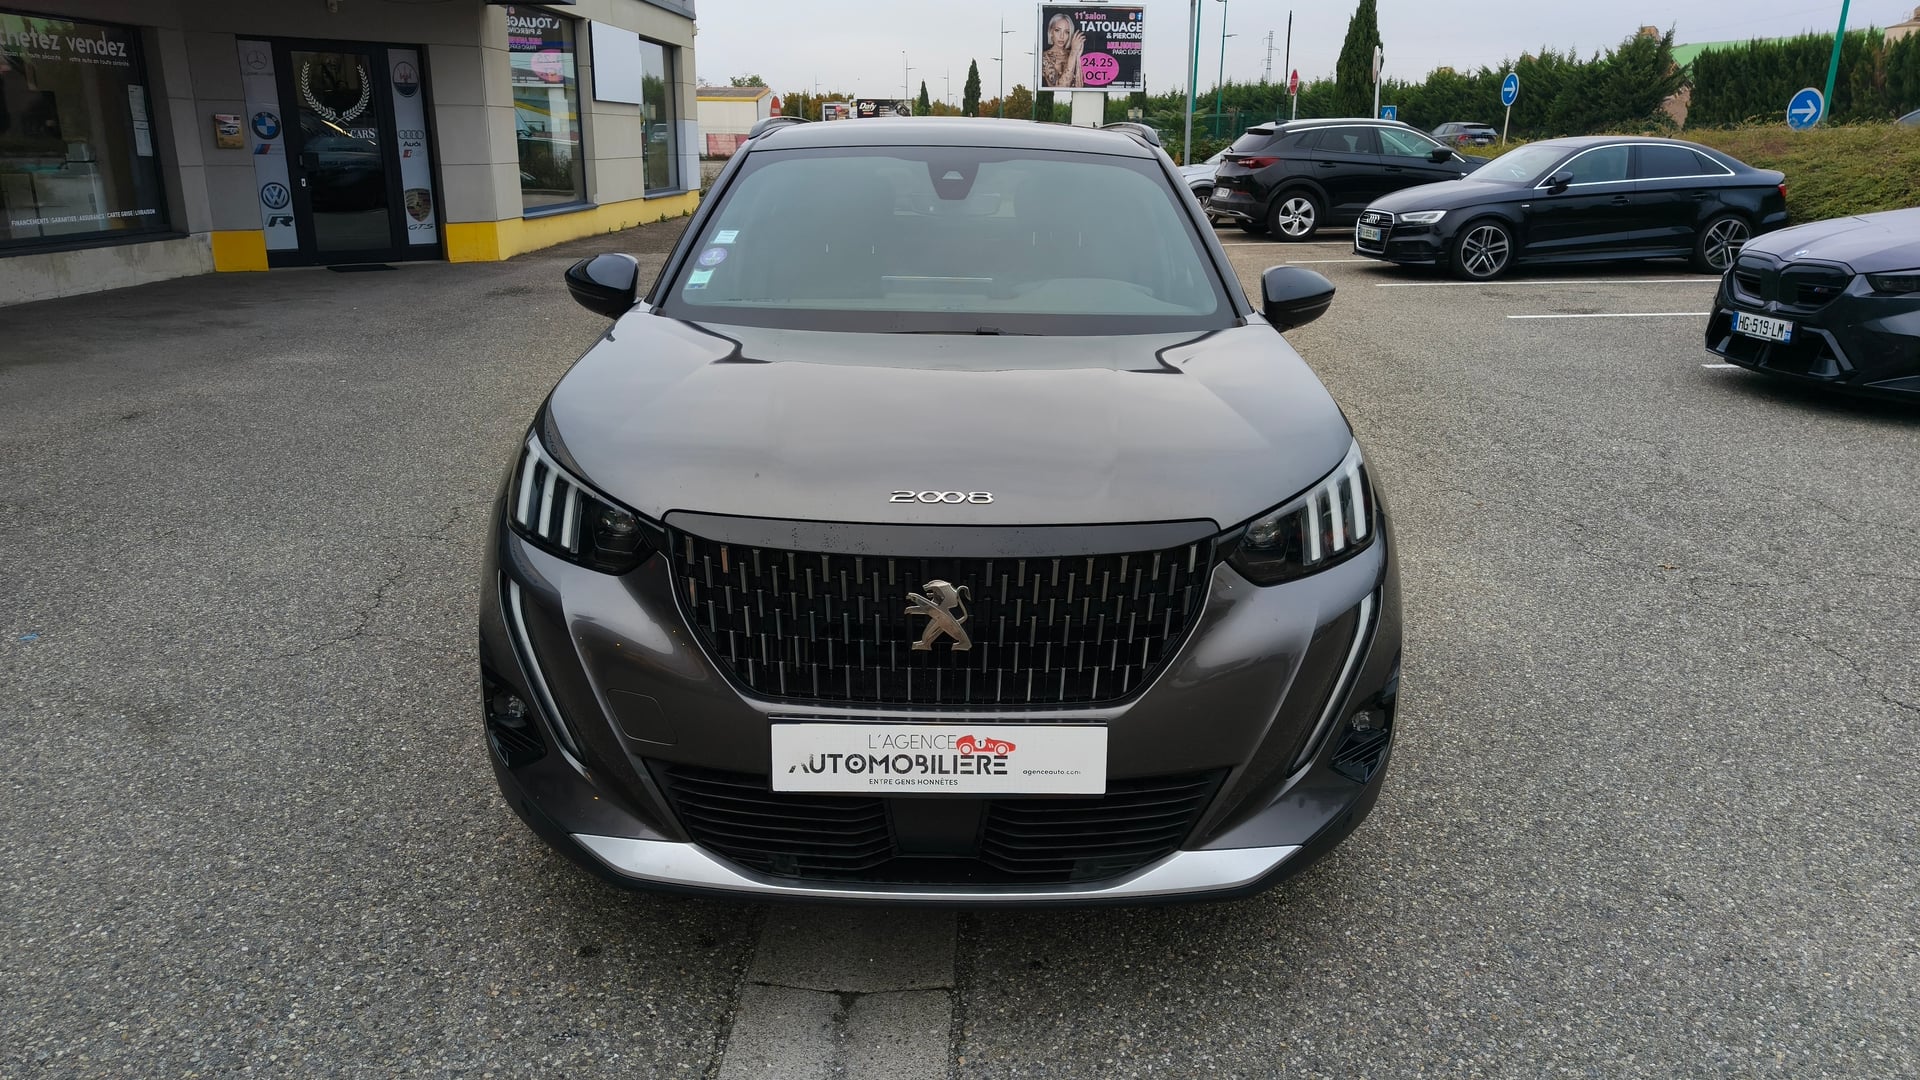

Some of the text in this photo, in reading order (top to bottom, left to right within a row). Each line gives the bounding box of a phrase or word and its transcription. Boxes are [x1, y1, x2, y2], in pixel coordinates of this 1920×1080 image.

[1085, 12, 1106, 20] salon
[1080, 21, 1142, 32] TATOUAGE
[65, 31, 127, 57] vendez
[1083, 58, 1113, 67] 24.25
[1085, 71, 1110, 80] OCT.
[350, 128, 376, 138] CARS
[1739, 315, 1785, 338] HG-519-LM
[889, 490, 994, 504] 2008
[868, 734, 957, 750] L'AGENCE
[917, 777, 958, 786] HONNÊTES
